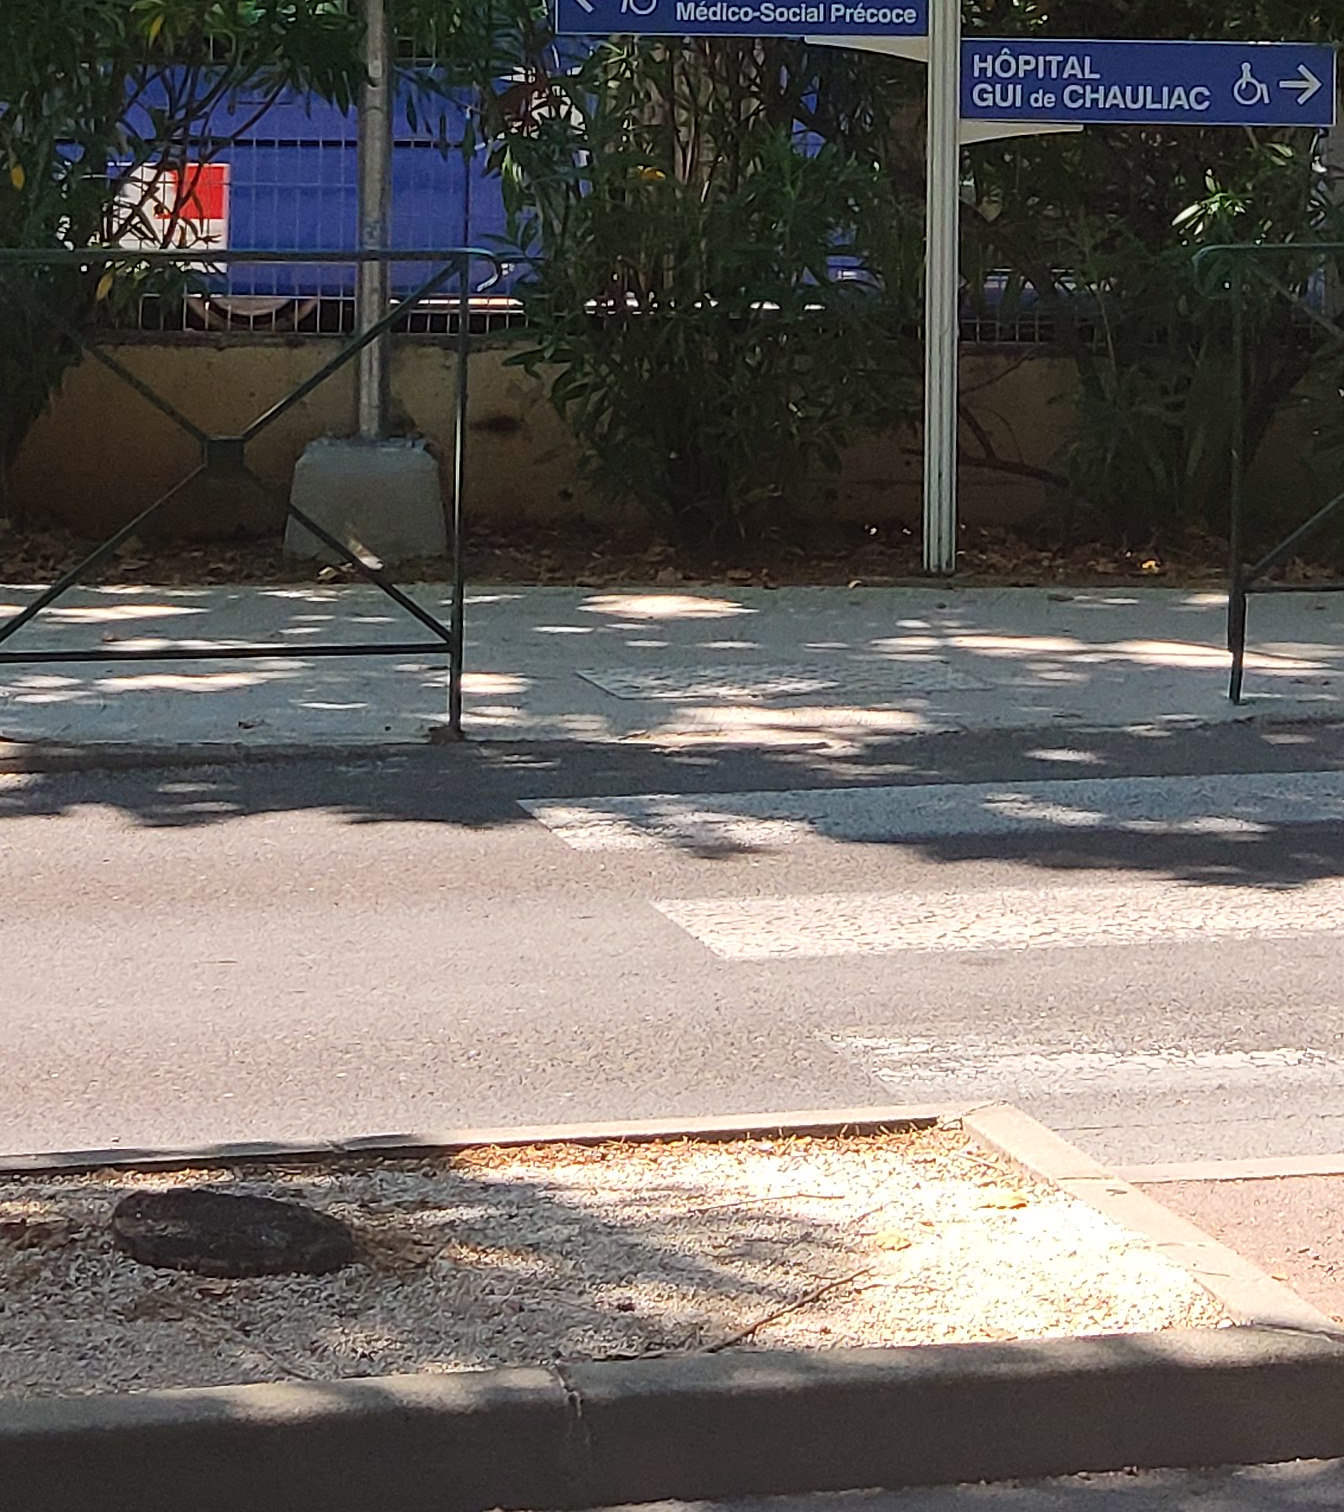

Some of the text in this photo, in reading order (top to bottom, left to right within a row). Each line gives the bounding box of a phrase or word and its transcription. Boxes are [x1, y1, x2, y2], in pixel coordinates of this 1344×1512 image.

[675, 1, 917, 25] Médico-Social Précoce
[972, 48, 1100, 80] HÔPITAL
[972, 82, 1211, 111] GUI de CHAULIAC
